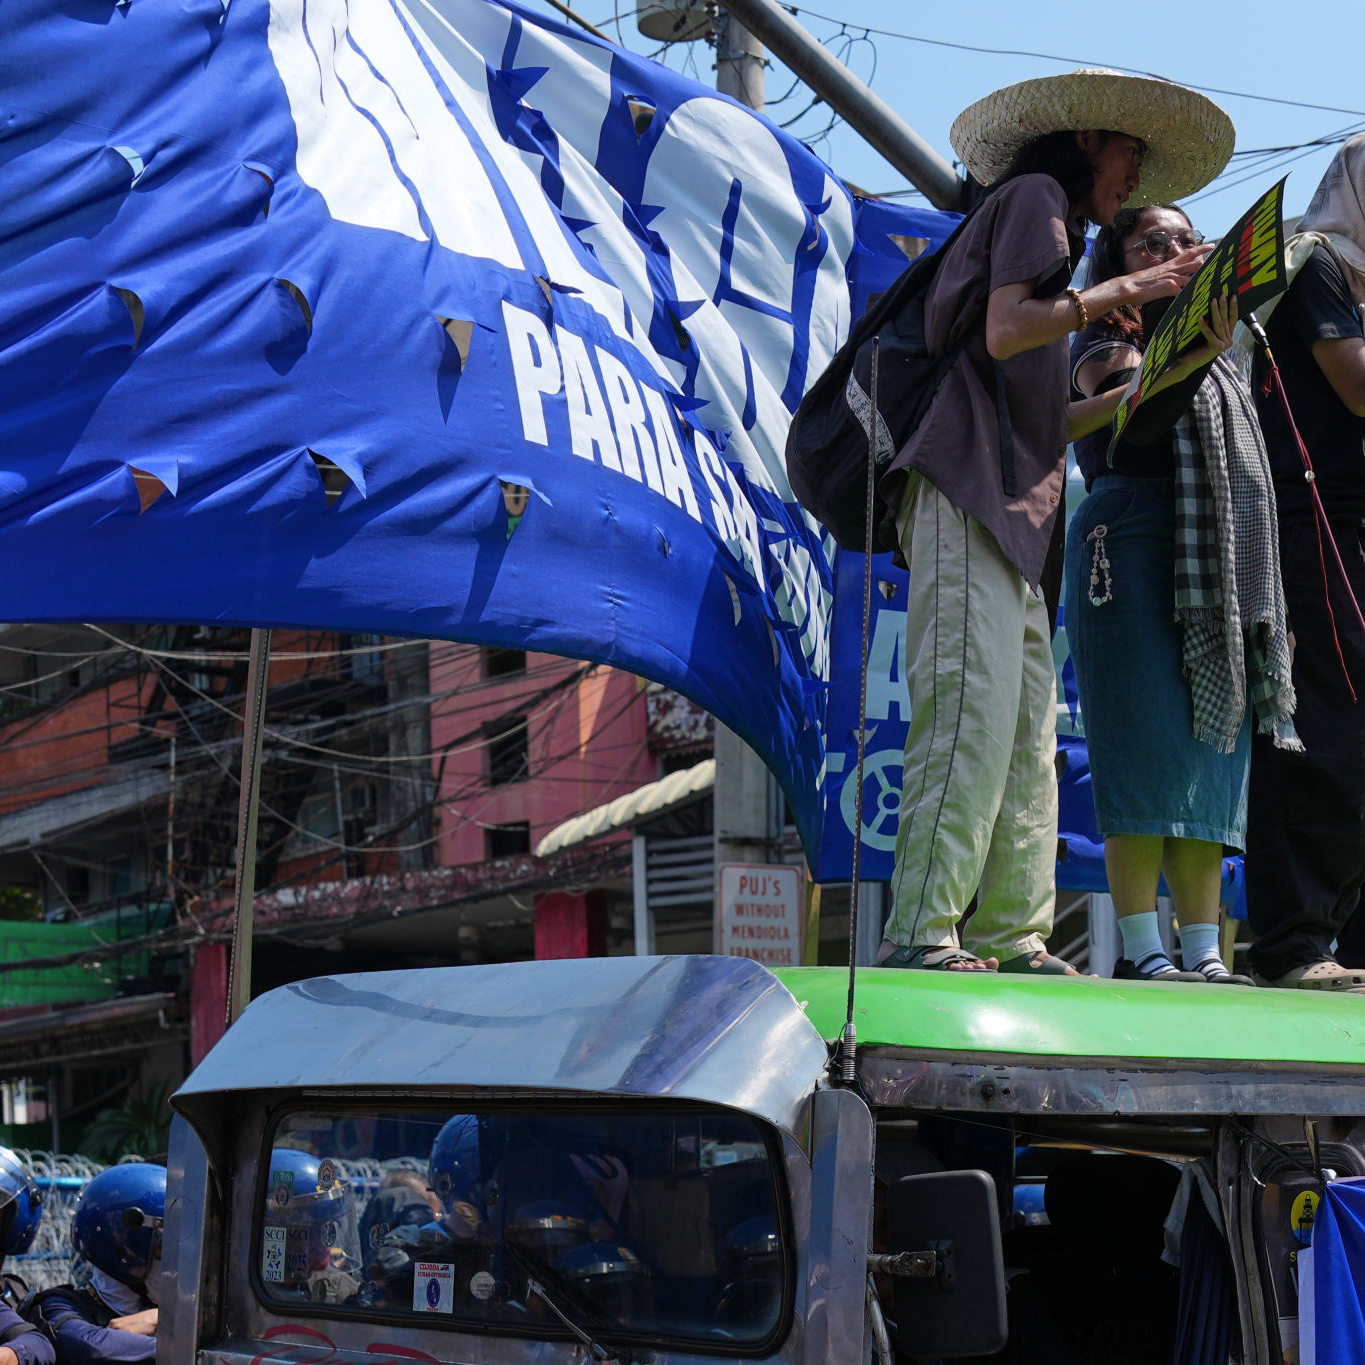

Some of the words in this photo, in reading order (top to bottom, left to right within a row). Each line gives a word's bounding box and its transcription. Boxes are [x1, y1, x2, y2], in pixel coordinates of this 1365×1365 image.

[502, 299, 703, 525] PARA
[735, 903, 786, 919] WITHOUT
[731, 924, 789, 940] MENDIOLA
